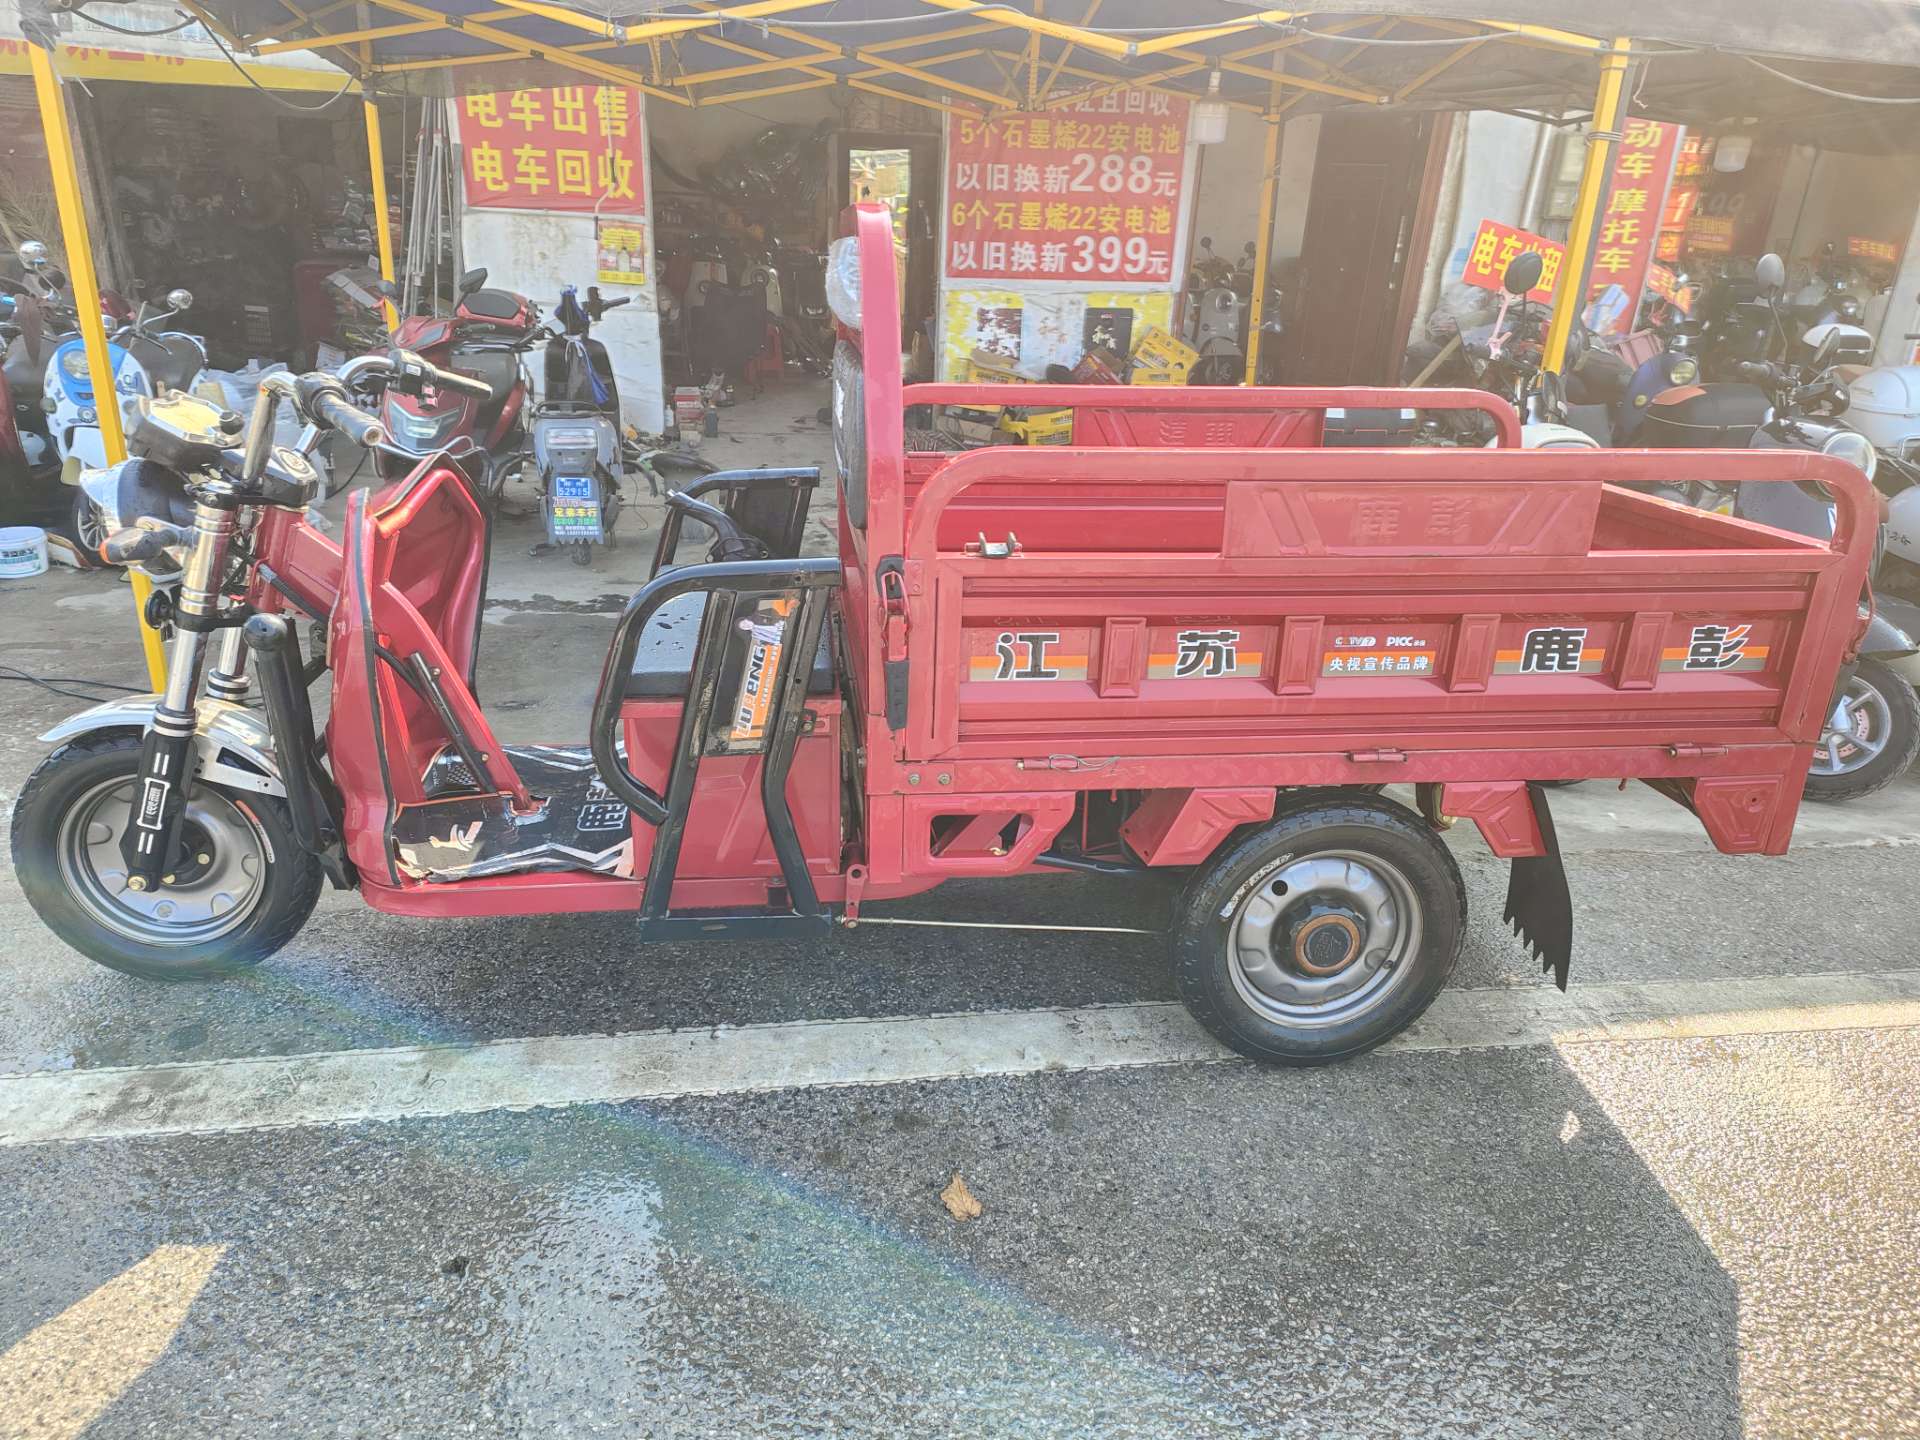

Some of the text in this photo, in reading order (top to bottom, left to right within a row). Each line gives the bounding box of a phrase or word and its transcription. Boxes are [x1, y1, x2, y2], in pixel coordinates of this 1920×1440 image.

[466, 87, 629, 137] 电车出售
[960, 119, 1181, 154] 5个石墨烯22安电池
[471, 141, 636, 200] 电车回收
[955, 152, 1177, 197] 以旧换新288元
[952, 200, 1172, 234] 6个石墨烯22安电池
[952, 235, 1170, 275] 以旧换新399元
[1473, 227, 1563, 292] 电车租
[995, 625, 1753, 681] 江 苏 鹿 彭
[1386, 635, 1414, 647] PICC
[1329, 655, 1429, 672] 央视宣传品牌
